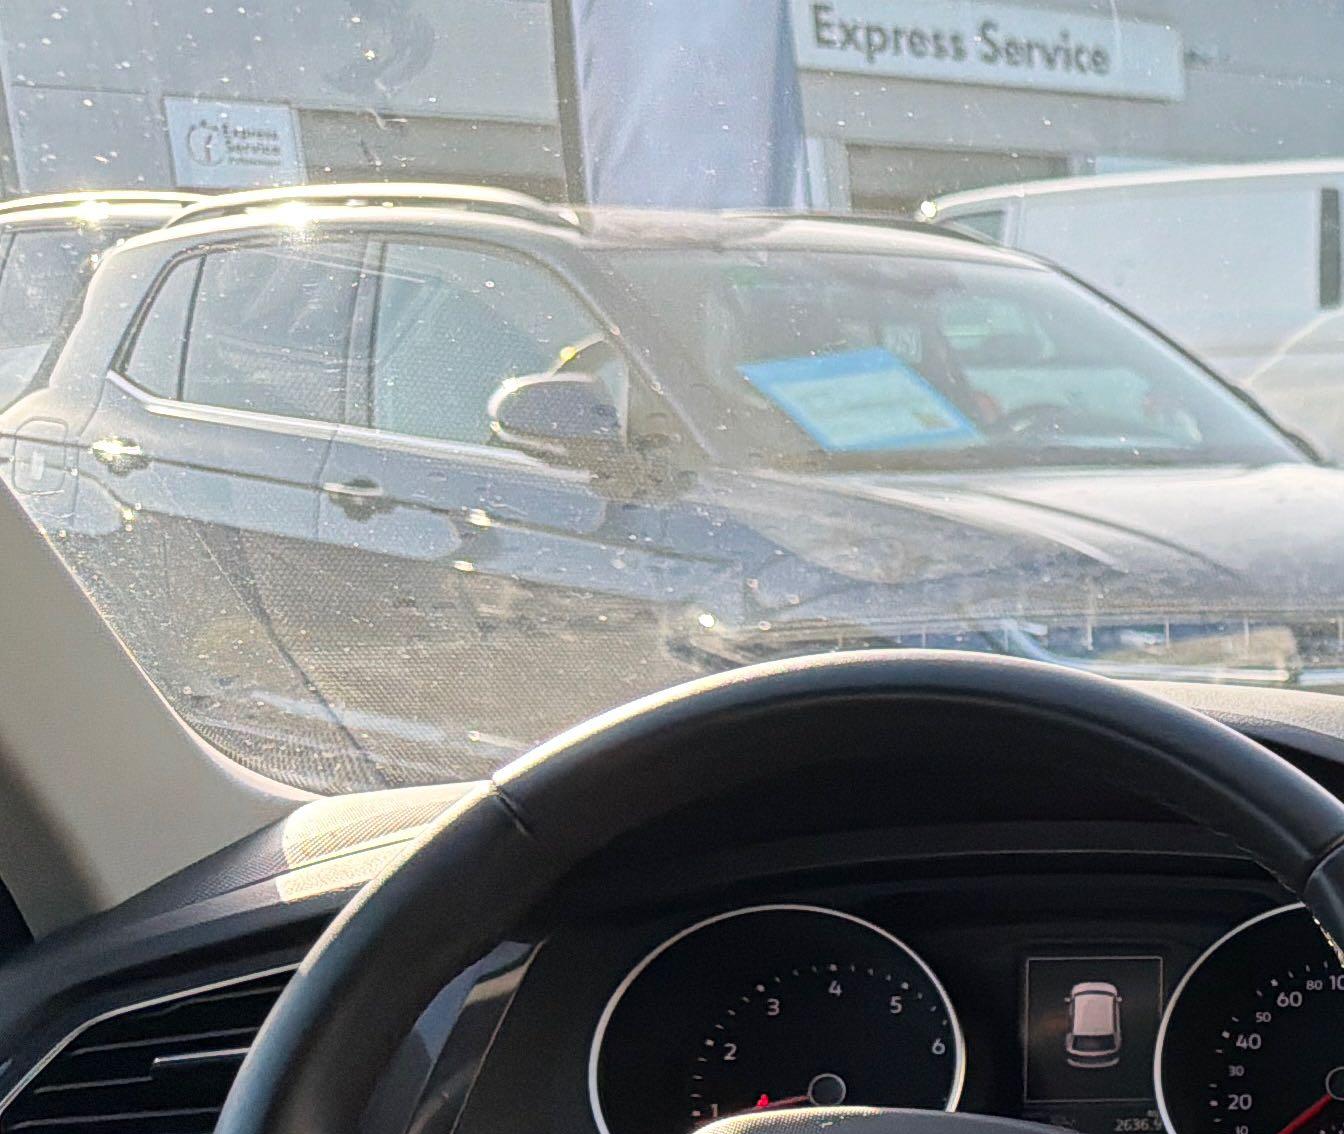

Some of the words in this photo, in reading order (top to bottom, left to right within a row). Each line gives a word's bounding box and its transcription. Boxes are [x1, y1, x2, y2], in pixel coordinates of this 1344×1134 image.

[811, 3, 968, 63] Express
[978, 20, 1113, 75] Service
[828, 981, 842, 996] 4
[1306, 979, 1323, 991] 80
[767, 998, 780, 1016] 3
[890, 996, 903, 1014] 5
[1276, 991, 1302, 1008] 60
[1255, 1011, 1271, 1023] 50
[932, 1038, 945, 1055] 6
[1235, 1033, 1261, 1050] 40
[723, 1043, 737, 1060] 2
[1228, 1065, 1244, 1076] 30
[1228, 1094, 1252, 1110] 20
